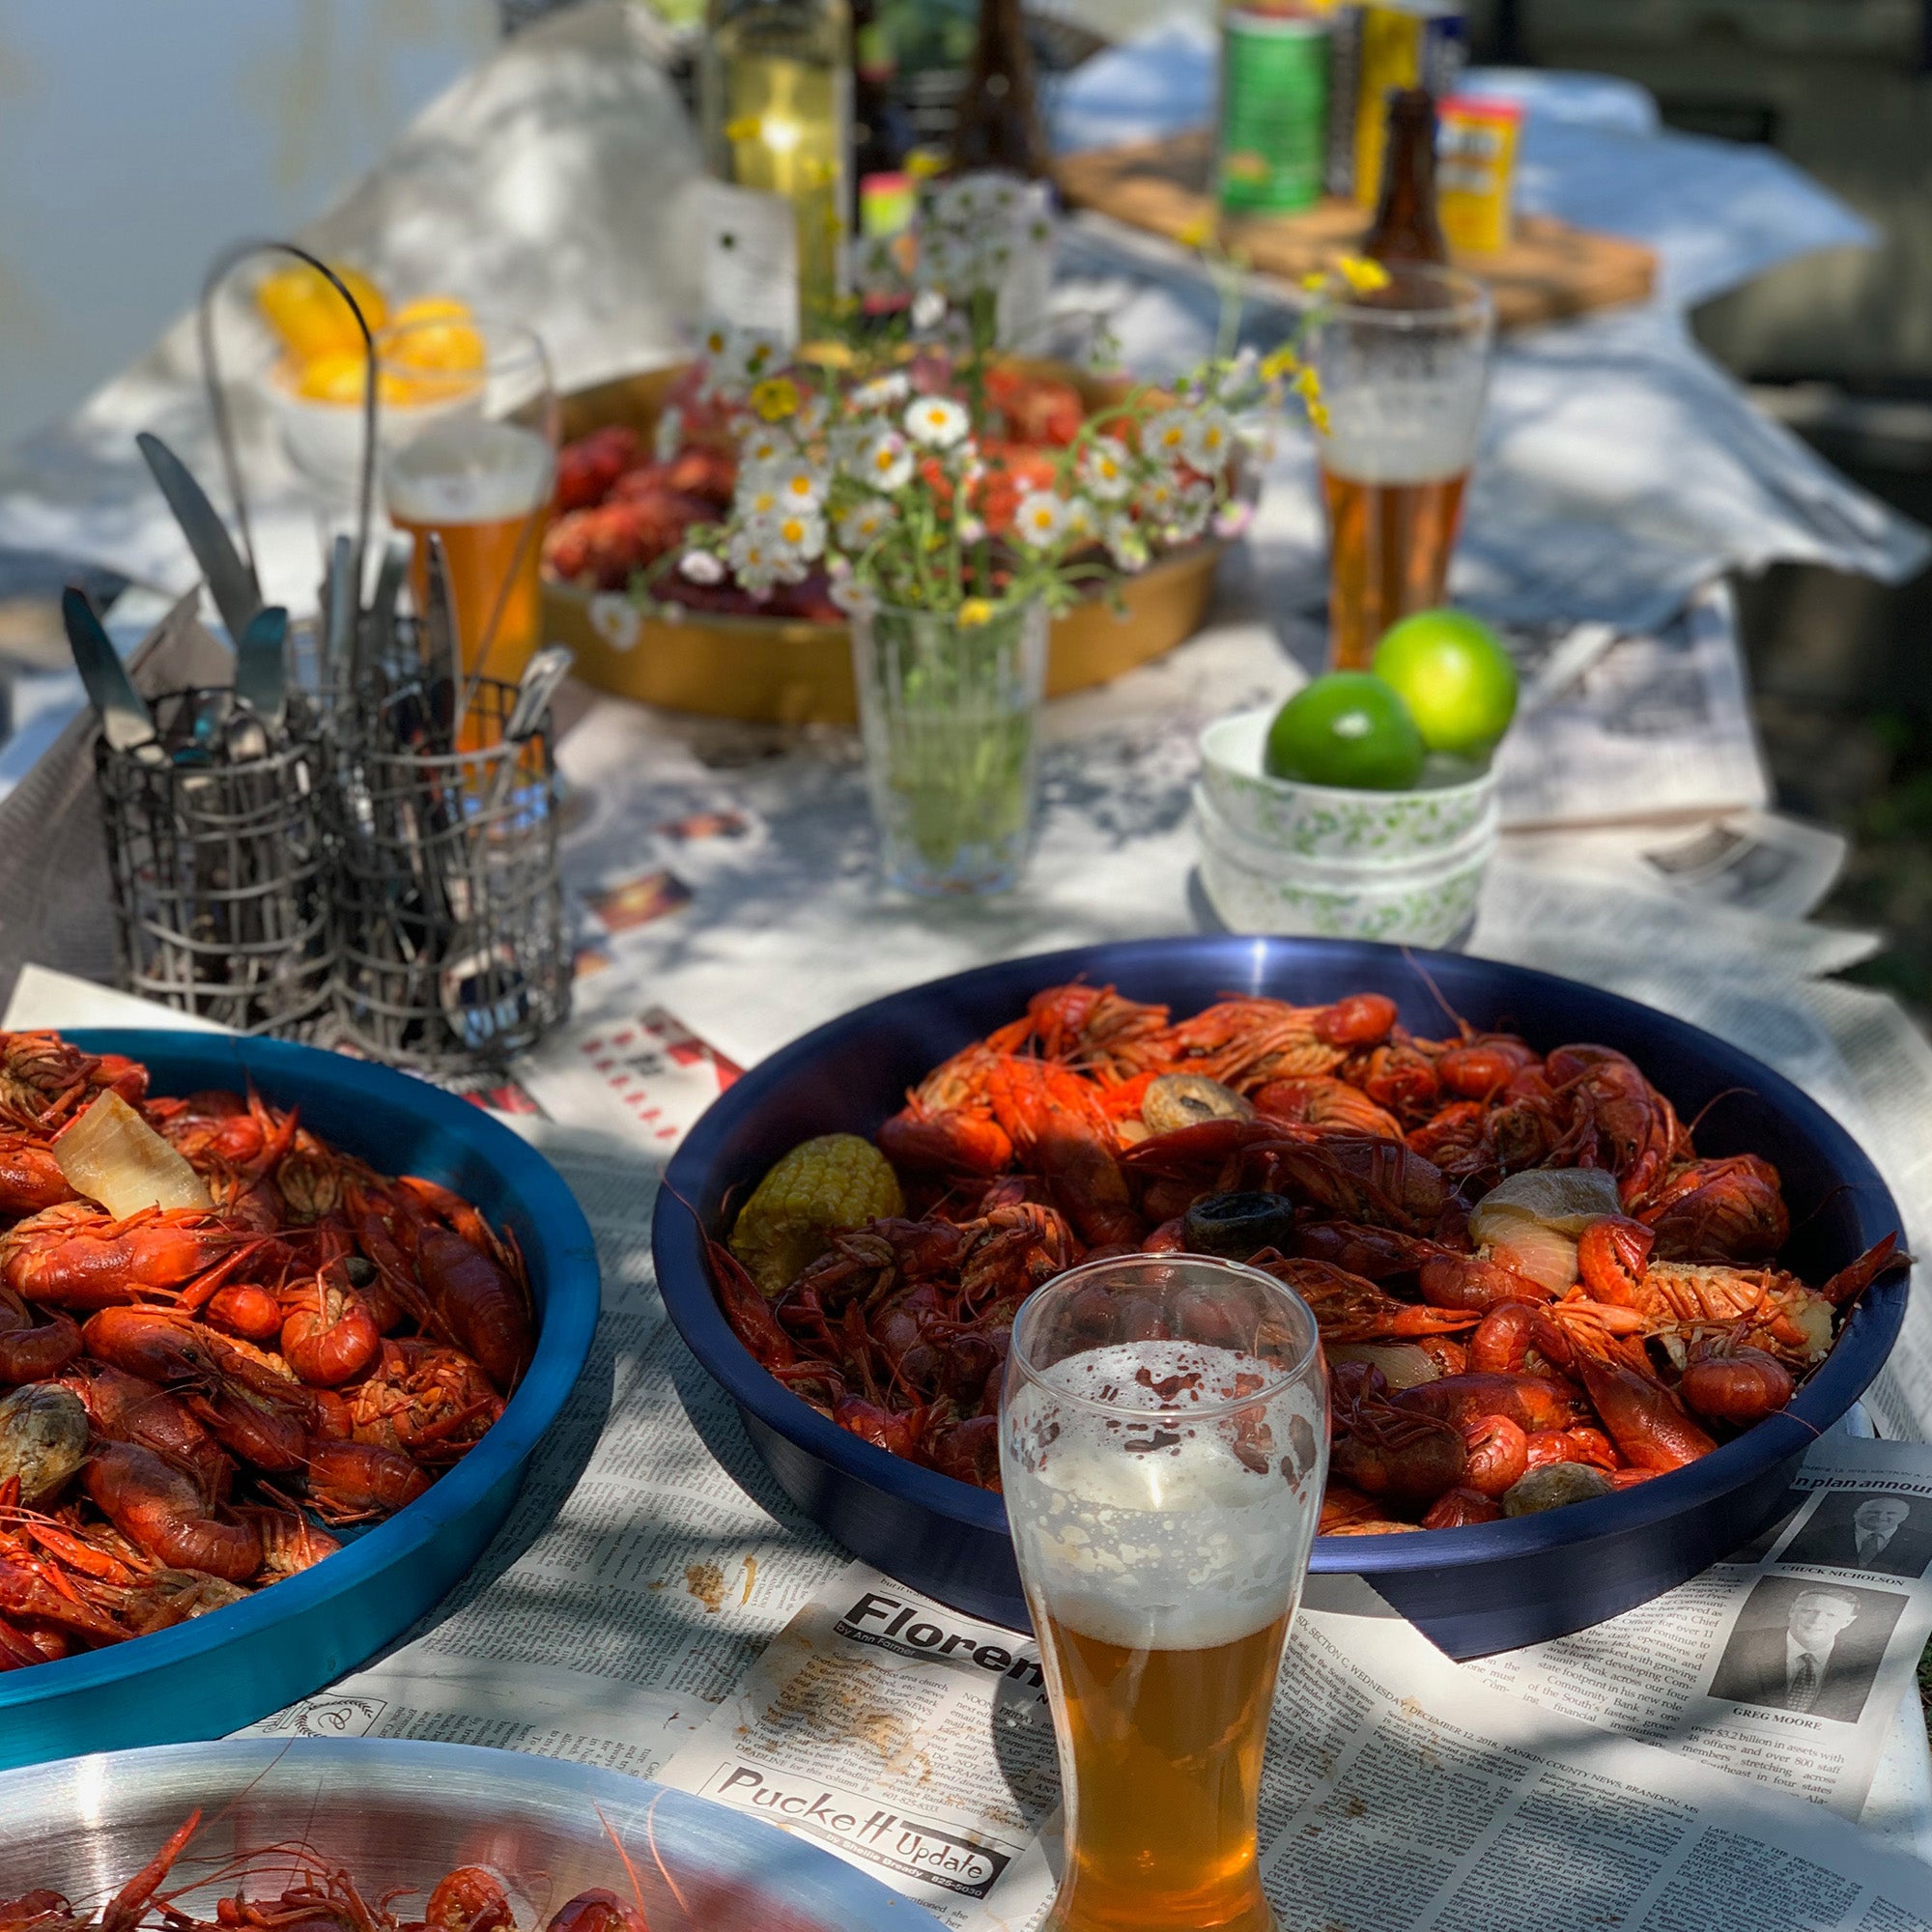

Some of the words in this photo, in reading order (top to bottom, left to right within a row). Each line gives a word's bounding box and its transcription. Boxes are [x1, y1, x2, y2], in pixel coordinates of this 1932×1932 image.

[1792, 1478, 1809, 1487] n
[1810, 1478, 1856, 1489] plan
[1782, 1565, 1826, 1575] CHUCK
[1829, 1571, 1905, 1586] NICHOLSON
[1659, 1619, 1674, 1629] for
[1677, 1626, 1699, 1634] over
[1691, 1616, 1719, 1627] Chief
[836, 1625, 850, 1635] by
[852, 1632, 875, 1644] Ann
[877, 1636, 916, 1656] Farmer
[1637, 1634, 1690, 1656] operations
[1654, 1629, 1696, 1646] continue
[1504, 1662, 1520, 1671] the
[1572, 1644, 1595, 1653] been
[1630, 1654, 1653, 1666] with
[1655, 1662, 1697, 1682] growing
[1611, 1640, 1651, 1653] Jackson
[1656, 1651, 1676, 1662] area
[1682, 1660, 1702, 1671] and
[1328, 1667, 1347, 1686] South
[1490, 1670, 1516, 1683] must
[1543, 1654, 1579, 1666] munity
[1582, 1662, 1607, 1676] Bank
[1611, 1673, 1642, 1686] across
[1645, 1684, 1664, 1692] our
[1667, 1689, 1689, 1701] four
[1548, 1647, 1569, 1656] and
[1605, 1659, 1662, 1682] developing
[1664, 1675, 1693, 1690] Com-
[899, 1675, 918, 1684] area
[920, 1678, 950, 1692] church,
[1537, 1662, 1561, 1672] state
[1562, 1666, 1606, 1690] footprint
[1608, 1683, 1619, 1691] in
[1620, 1688, 1636, 1698] his
[1637, 1692, 1662, 1704] new
[1662, 1698, 1684, 1712] role.
[915, 1694, 939, 1708] mark
[922, 1690, 945, 1700] news
[1548, 1676, 1608, 1702] Community
[1614, 1698, 1639, 1712] Bank
[1661, 1713, 1680, 1722] one
[901, 1699, 934, 1717] NEWS
[998, 1707, 1035, 1725] FRIDAY
[1543, 1688, 1558, 1697] the
[1563, 1692, 1600, 1712] South's
[1604, 1708, 1639, 1722] fastest-
[1643, 1720, 1676, 1731] grow-
[1733, 1707, 1770, 1720] GREG
[1773, 1715, 1823, 1730] MOORE
[1309, 1628, 1343, 1659] SECTION
[1342, 1658, 1350, 1668] C,
[1350, 1664, 1407, 1710] WEDNESDAY,
[1408, 1706, 1462, 1735] DECEMBER
[1502, 1745, 1546, 1765] RANKIN
[1547, 1760, 1589, 1778] COUNTY
[1591, 1774, 1623, 1788] NEWS,
[1625, 1784, 1680, 1808] BRANDON,
[1683, 1804, 1699, 1814] MS
[1553, 1704, 1597, 1722] financial
[1610, 1721, 1667, 1740] institutions
[530, 1736, 543, 1746] To
[601, 1740, 614, 1751] for
[1691, 1725, 1715, 1736] over
[1718, 1729, 1738, 1740] $3.2
[1739, 1733, 1773, 1747] billion
[1787, 1744, 1817, 1757] assets
[1820, 1751, 1844, 1763] with
[605, 1742, 625, 1767] always
[627, 1746, 638, 1759] and
[735, 1744, 785, 1766] DEADLINE
[932, 1752, 949, 1761] DO
[956, 1759, 980, 1770] NOT
[1703, 1739, 1737, 1751] offices
[1741, 1747, 1761, 1756] and
[1766, 1752, 1791, 1763] over
[1795, 1757, 1813, 1768] 800
[1816, 1763, 1842, 1775] staff
[615, 1761, 629, 1771] try
[1682, 1744, 1730, 1762] members
[1741, 1759, 1792, 1777] stretching
[1803, 1773, 1836, 1784] across
[1757, 1773, 1768, 1781] in
[1774, 1776, 1797, 1788] four
[1802, 1783, 1833, 1795] states
[922, 1793, 953, 1807] Rankin
[954, 1803, 988, 1819] County
[989, 1814, 1016, 1826] News
[1805, 1795, 1829, 1804] Ala-
[717, 1766, 897, 1843] Puckett
[895, 1832, 983, 1880] Update
[931, 1875, 982, 1897] 825-5030
[906, 1893, 948, 1916] ntioned
[952, 1909, 969, 1920] she
[945, 1916, 963, 1928] her
